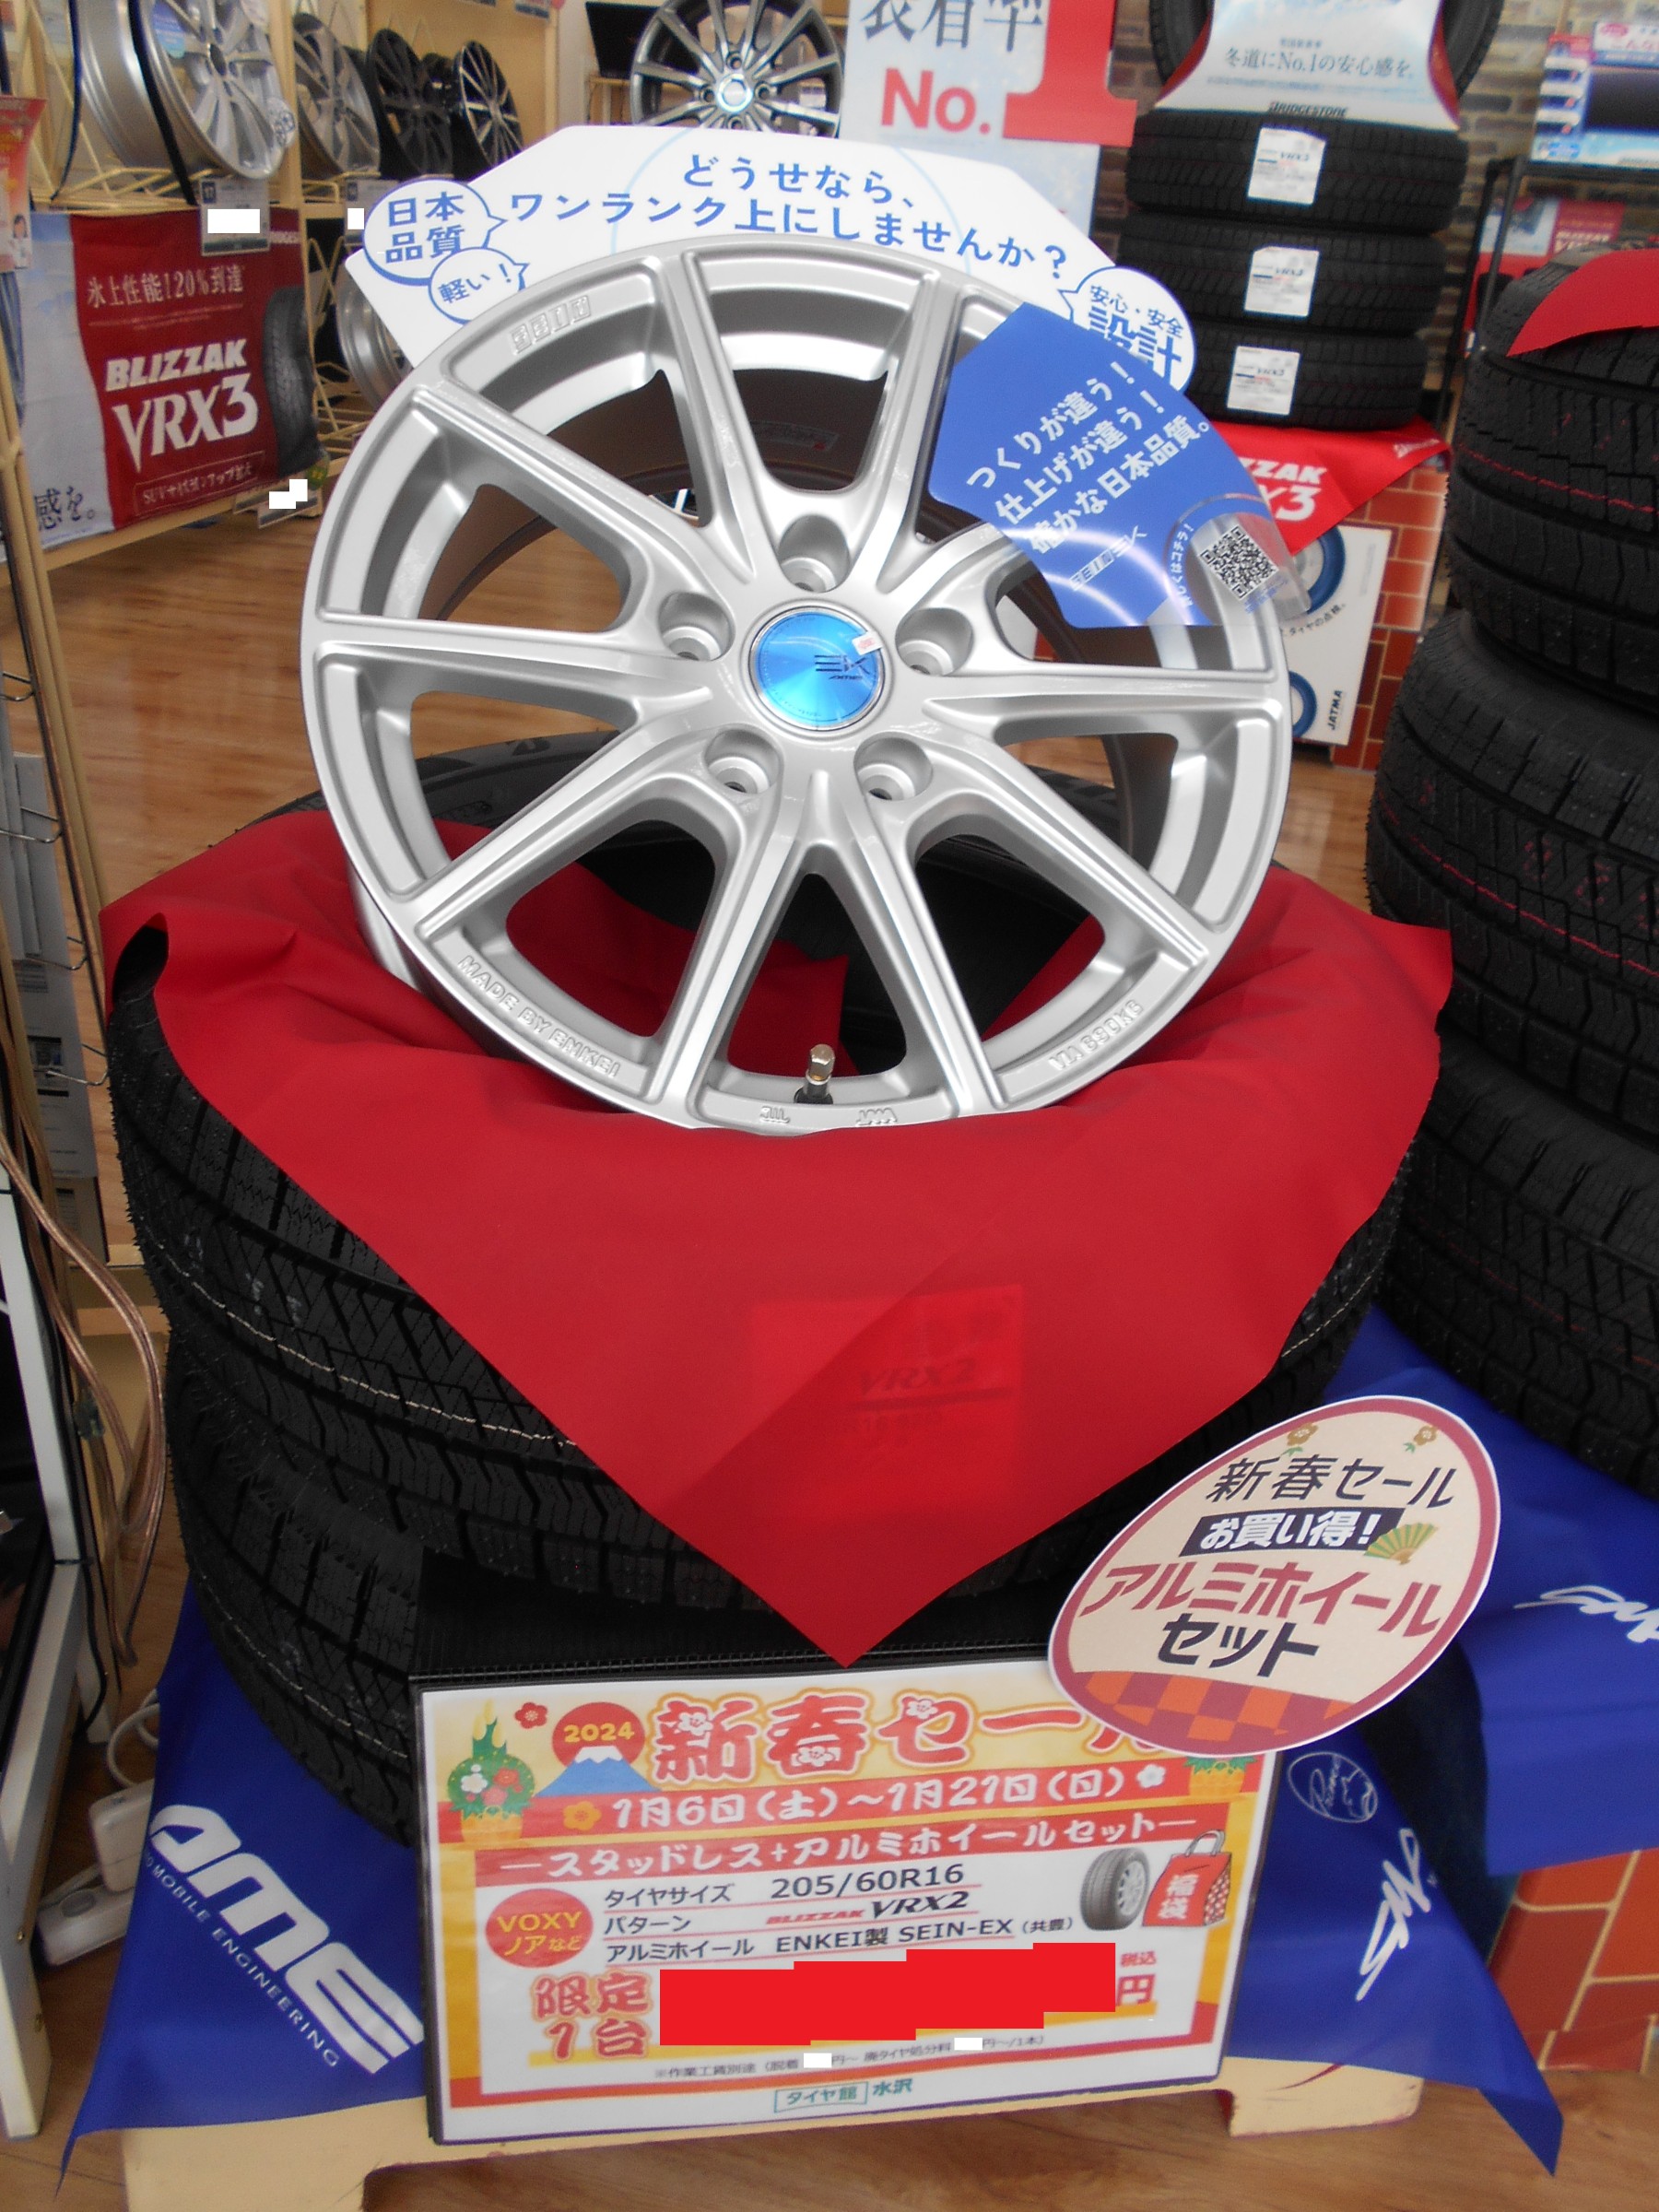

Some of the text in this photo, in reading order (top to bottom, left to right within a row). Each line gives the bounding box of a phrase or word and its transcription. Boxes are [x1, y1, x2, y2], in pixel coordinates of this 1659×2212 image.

[1267, 100, 1348, 118] BRIDGESTONE
[684, 154, 915, 207] どうせなら、
[387, 192, 465, 228] 日本
[384, 227, 466, 264] 品質
[1089, 285, 1184, 338] 安心・安全
[106, 338, 247, 392] BLIZZAK
[112, 372, 259, 474] VRX3
[1327, 689, 1343, 731] JATMA
[457, 955, 621, 1078] MADE BY ENKEI
[1206, 1454, 1457, 1509] 新春セール
[1079, 1561, 1443, 1638] アルミホイール
[1158, 1613, 1321, 1677] セット
[563, 1721, 636, 1744] 2024
[605, 1882, 735, 1910] タイヤサイズ
[771, 1863, 965, 1900] 205/60R16
[496, 1911, 582, 1933] VOXY
[605, 1915, 692, 1936] パターン
[765, 1891, 971, 1925] BLIZZAK VRX2
[502, 1934, 582, 1957] ノアなど
[606, 1936, 756, 1962] アルミホイール
[775, 1924, 888, 1954] ENKEI製
[898, 1918, 1015, 1944] SEIN-EX
[211, 1926, 340, 2068] ENGINEERING
[535, 1971, 649, 2019] 限定
[1115, 1973, 1156, 2006] 円
[547, 2017, 648, 2060] 1台
[786, 2077, 913, 2106] タイヤ館 水沢
